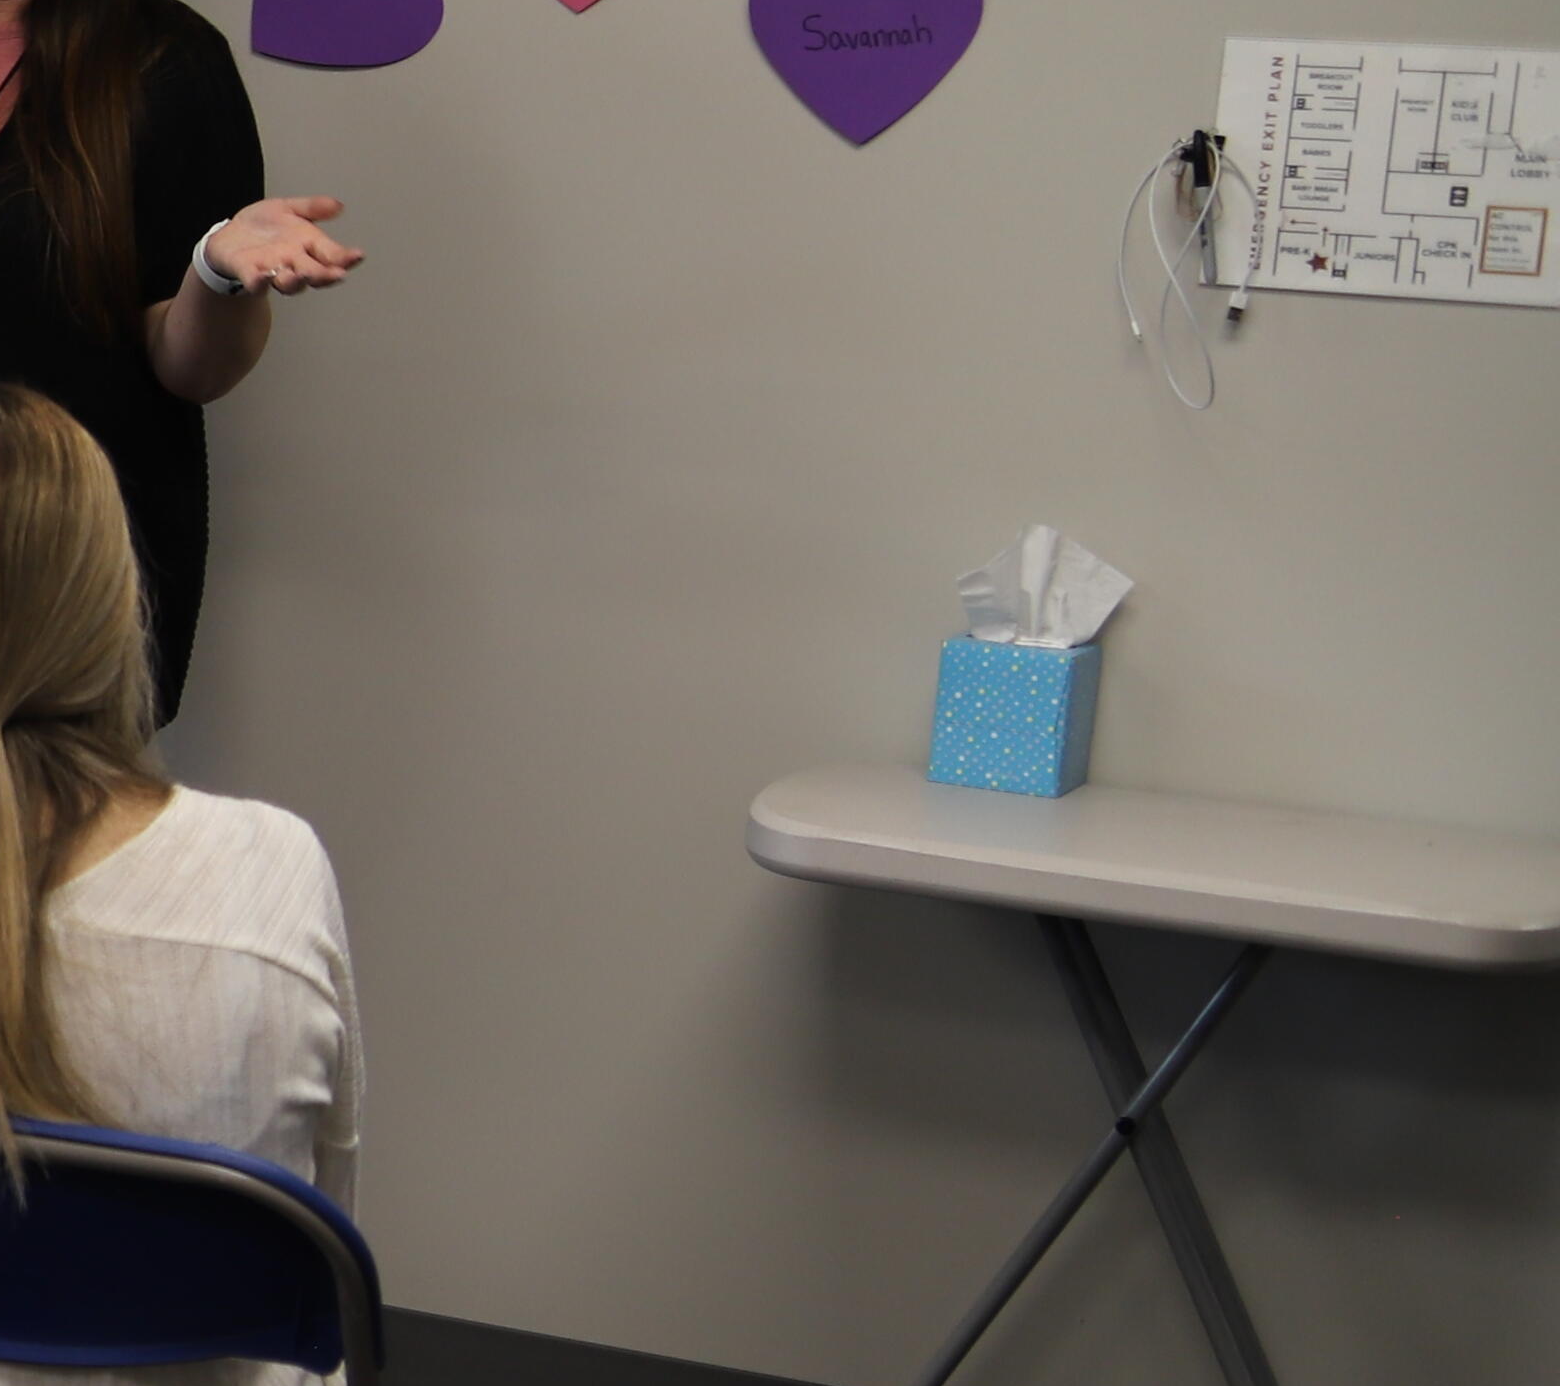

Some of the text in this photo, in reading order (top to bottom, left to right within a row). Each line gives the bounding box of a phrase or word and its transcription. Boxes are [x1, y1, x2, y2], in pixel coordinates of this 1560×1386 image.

[802, 14, 933, 53] Savannah
[1249, 56, 1284, 271] EMERGENCY EXIT PLAN
[1510, 169, 1550, 178] LOBBY
[1354, 252, 1396, 262] JUNIORS
[1421, 250, 1457, 258] CHECK
